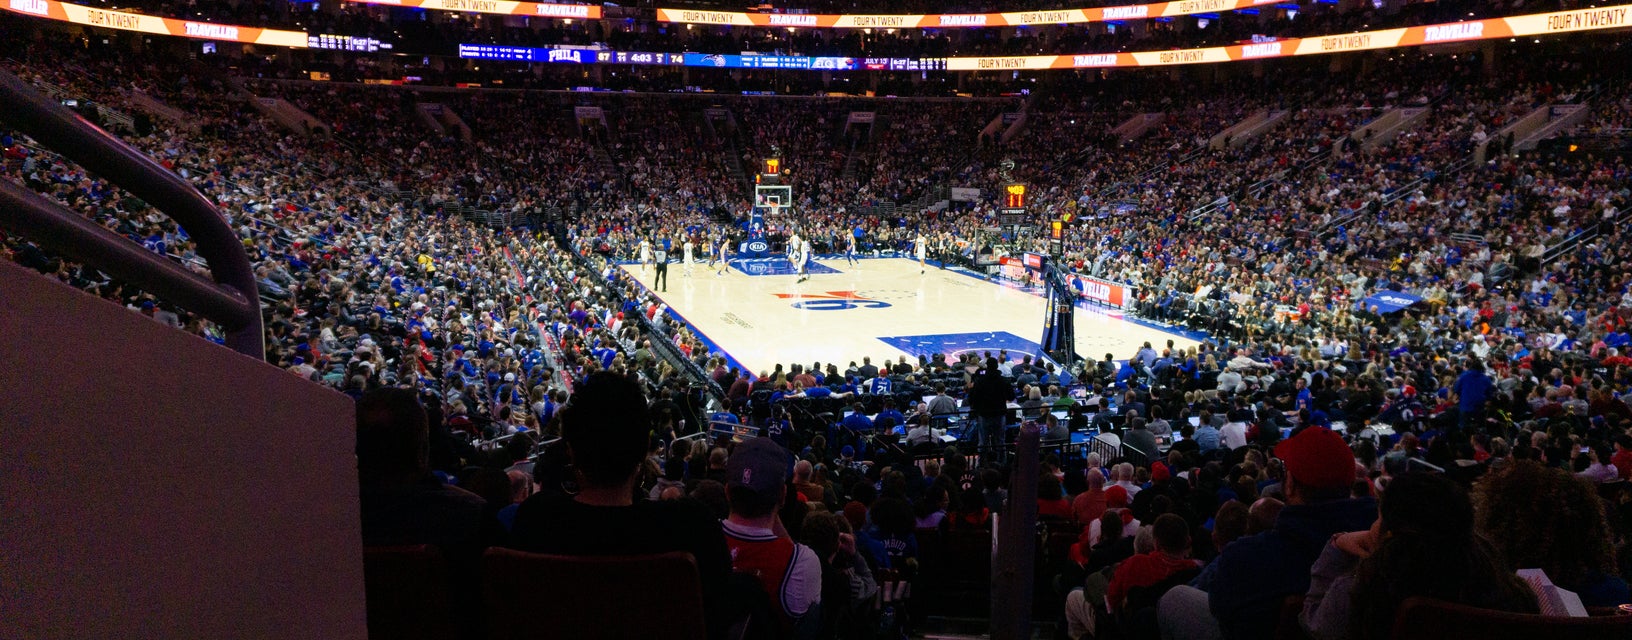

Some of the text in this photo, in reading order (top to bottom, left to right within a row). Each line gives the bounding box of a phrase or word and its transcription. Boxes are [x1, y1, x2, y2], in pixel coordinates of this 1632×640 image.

[467, 1, 497, 11] TWENTY
[537, 4, 588, 16] TRAVELLER
[1044, 12, 1070, 22] TWENTY
[1102, 6, 1148, 18] TRAVELLER
[1584, 8, 1626, 26] TWENTY
[112, 13, 140, 29] TWENTY
[707, 13, 734, 23] TWENTY
[769, 15, 817, 25] TRAVELLER
[877, 17, 904, 26] TWENTY
[939, 15, 987, 25] TRAVELLER
[185, 22, 239, 40] TRAVELLER
[1424, 22, 1484, 42] TRAVELLER
[1344, 34, 1371, 49] TWENTY
[1242, 42, 1281, 58] TRAVELLER
[549, 50, 581, 62] PHILA
[598, 53, 610, 61] 87
[631, 54, 652, 62] 4:03
[670, 55, 683, 63] 74
[1073, 55, 1117, 66] TRAVELLER
[1181, 50, 1204, 62] TWENTY
[1001, 57, 1026, 67] TWENTY
